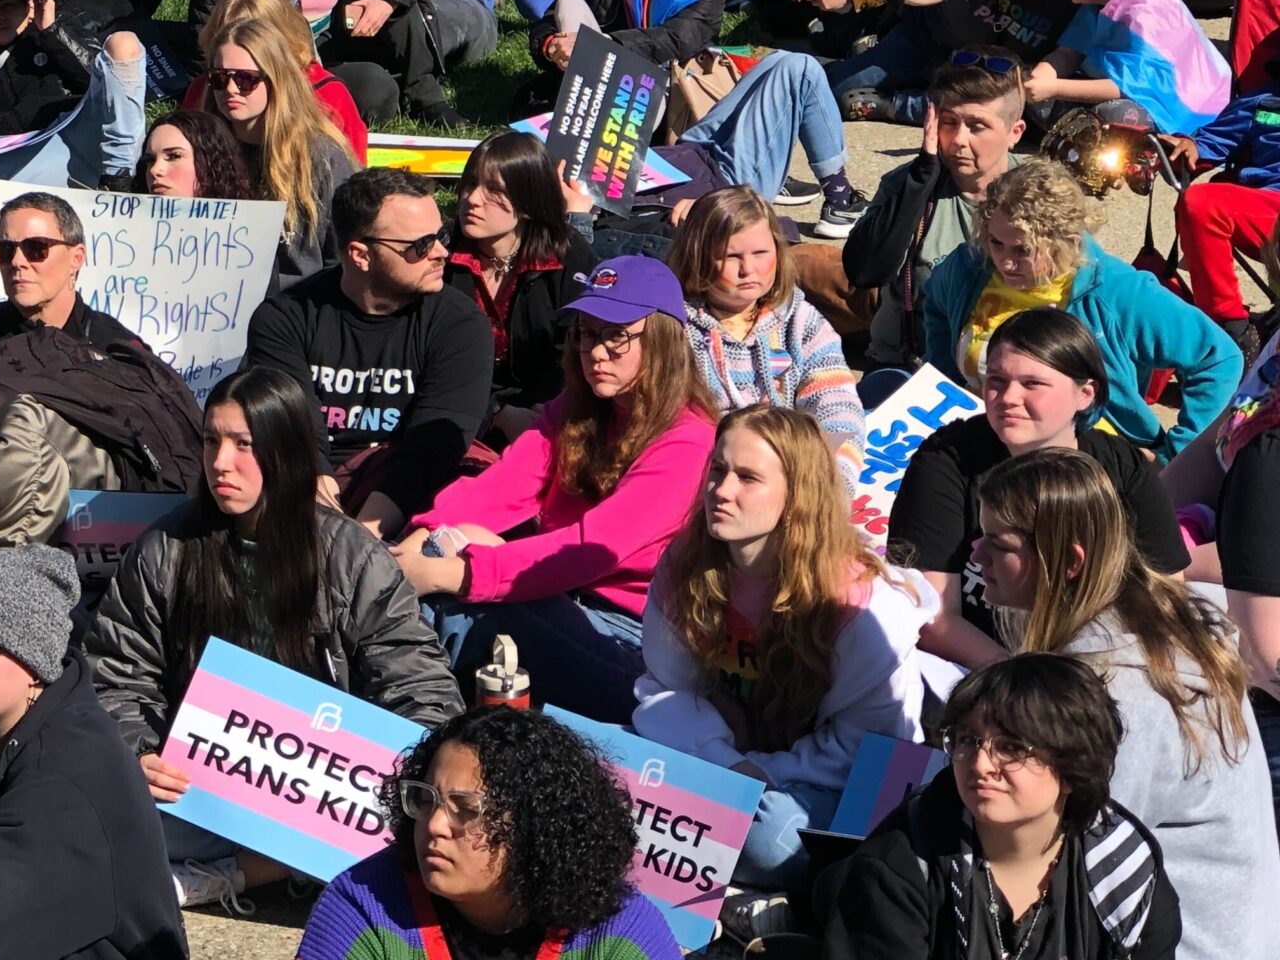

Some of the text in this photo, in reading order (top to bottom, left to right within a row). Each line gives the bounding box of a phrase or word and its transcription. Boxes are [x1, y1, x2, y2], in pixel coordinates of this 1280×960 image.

[602, 51, 618, 84] HERE
[559, 74, 584, 135] NO SHAME
[571, 86, 593, 137] NO FEAR
[583, 81, 608, 139] WELCOME
[590, 73, 635, 183] WE STAND
[577, 139, 590, 164] ARE
[606, 72, 655, 200] WITH PRIDE
[91, 193, 238, 221] STOP THE HATE!
[152, 220, 255, 284] Rights
[104, 274, 149, 296] are
[139, 279, 245, 346] Rights!
[187, 732, 396, 845] TRANS KID
[635, 797, 713, 849] TECT
[642, 843, 718, 893] KIDS
